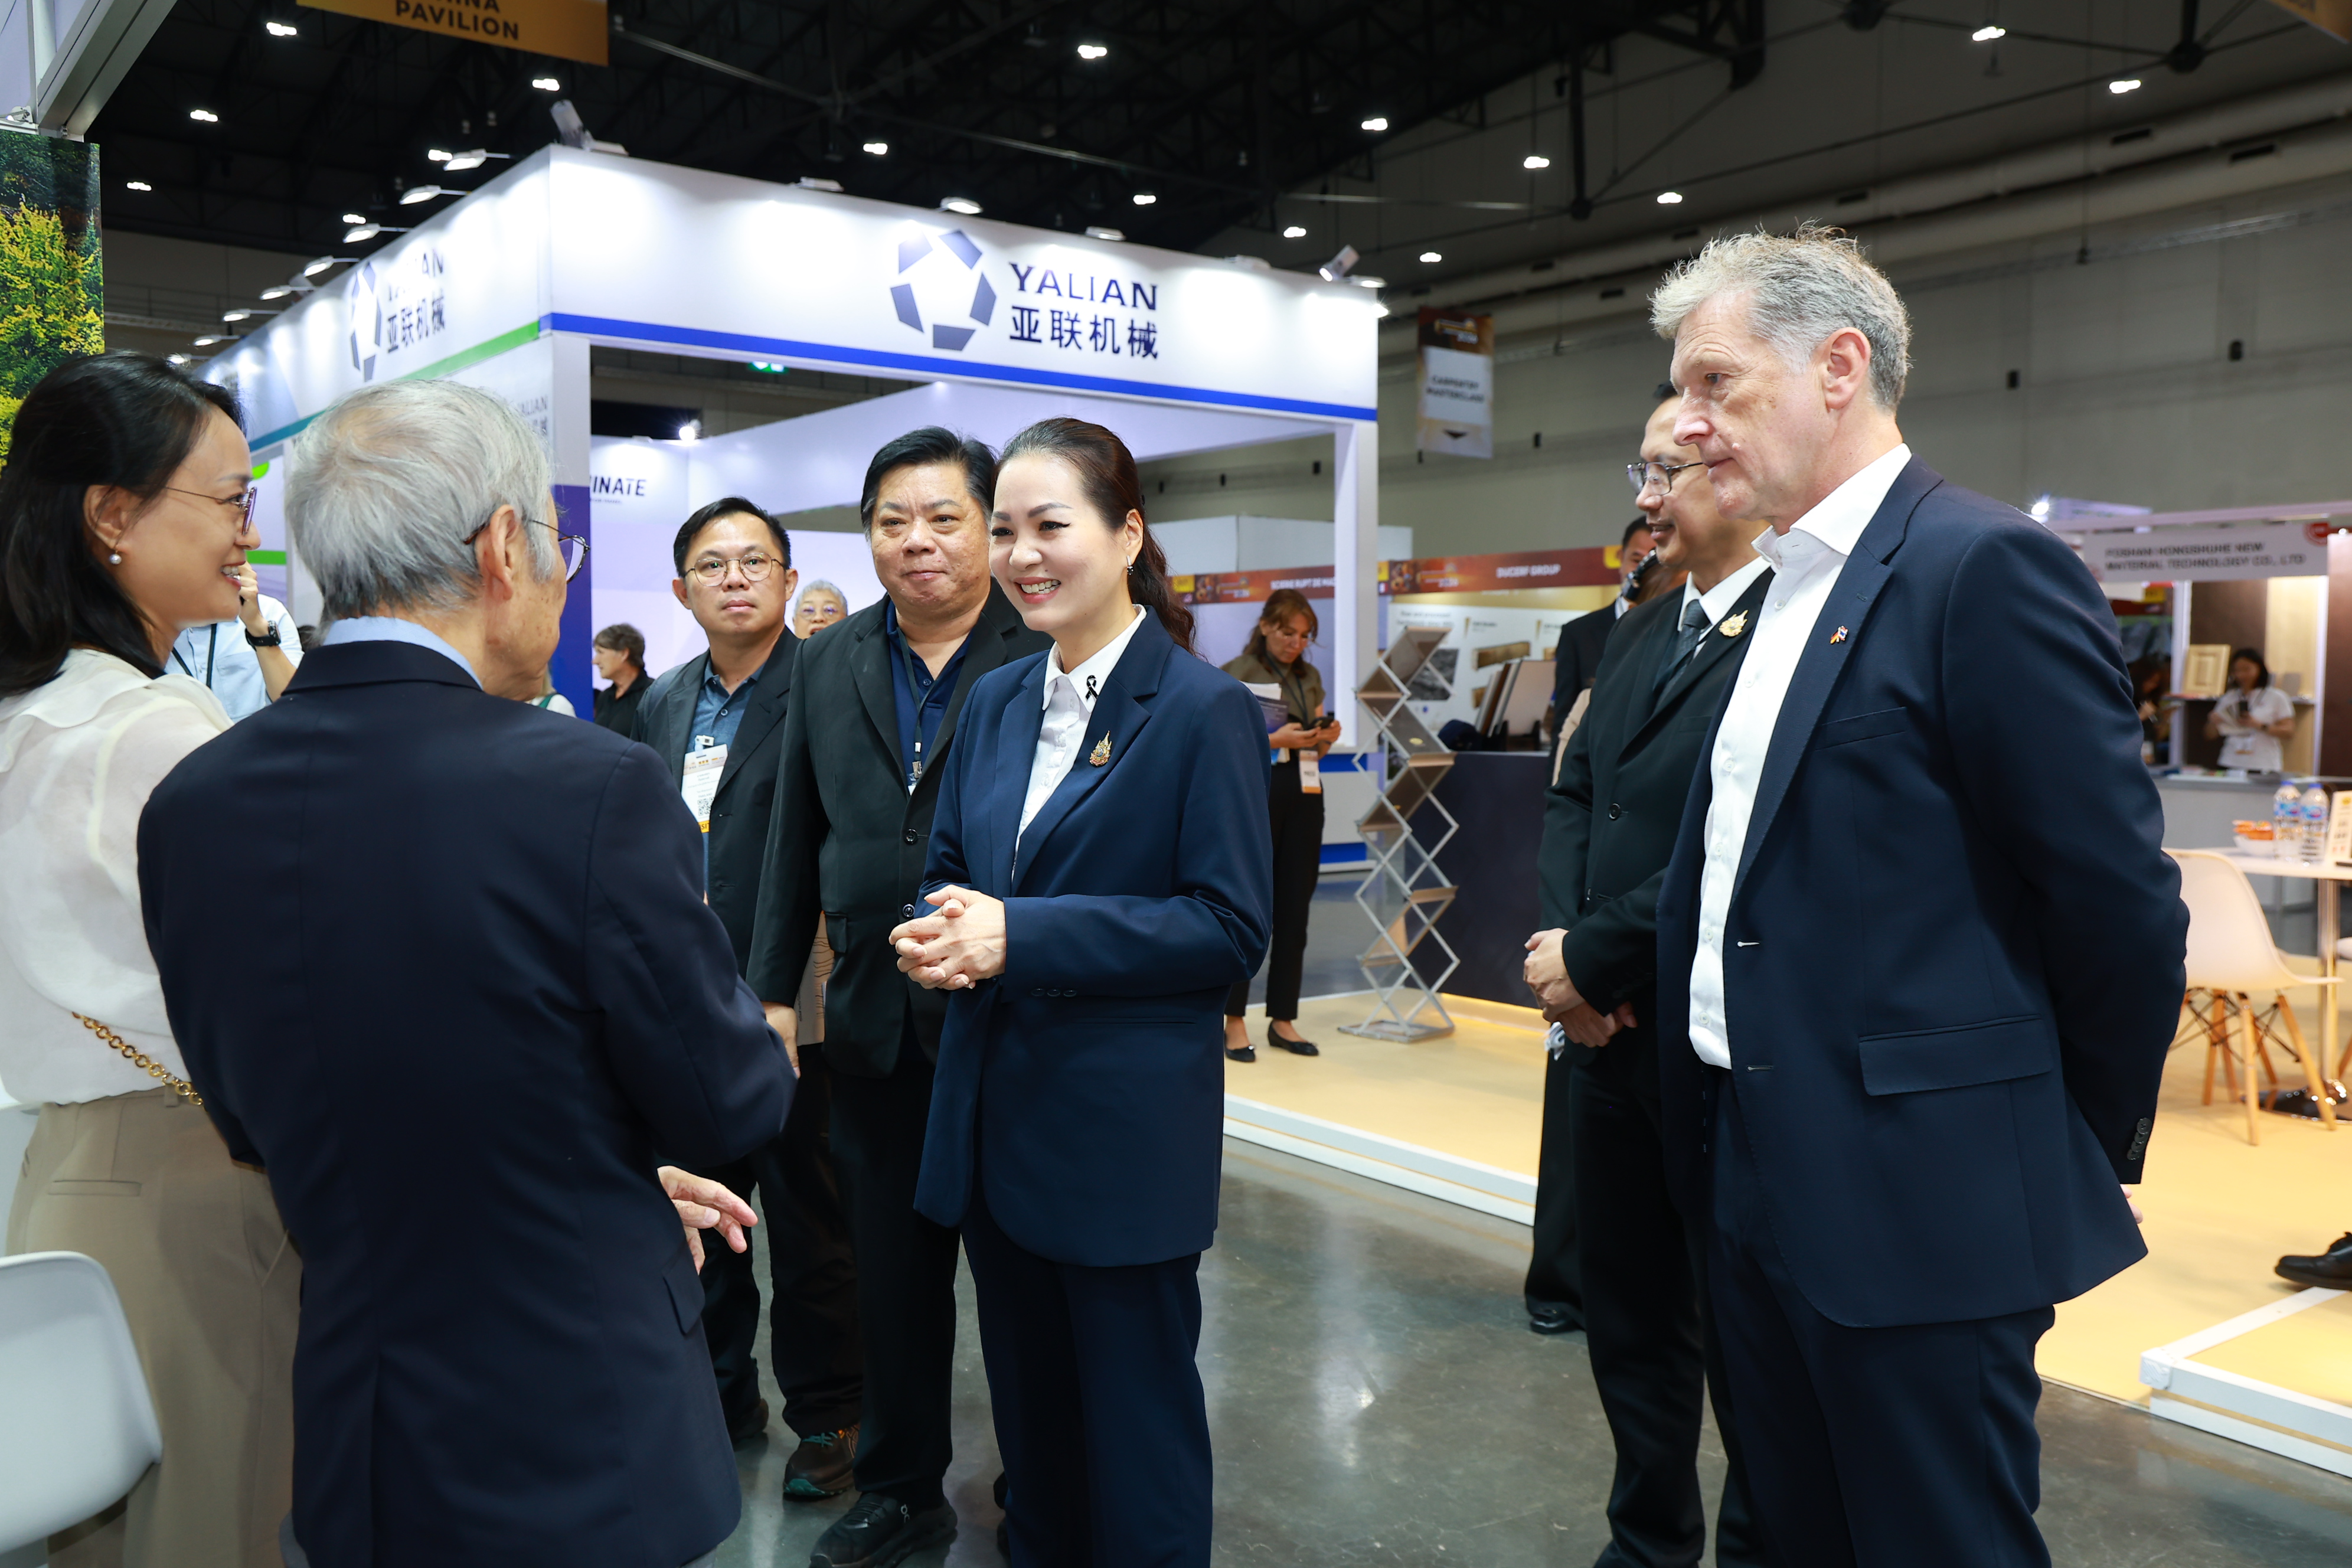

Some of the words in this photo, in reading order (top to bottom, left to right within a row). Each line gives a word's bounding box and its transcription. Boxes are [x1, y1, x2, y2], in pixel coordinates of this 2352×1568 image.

[396, 0, 519, 40] PAVILION
[1009, 262, 1157, 310] YALIAN
[1009, 305, 1158, 359] 亚联机械
[590, 475, 646, 496] INATE
[2234, 541, 2265, 553] NEW
[1530, 564, 1561, 577] GROUP
